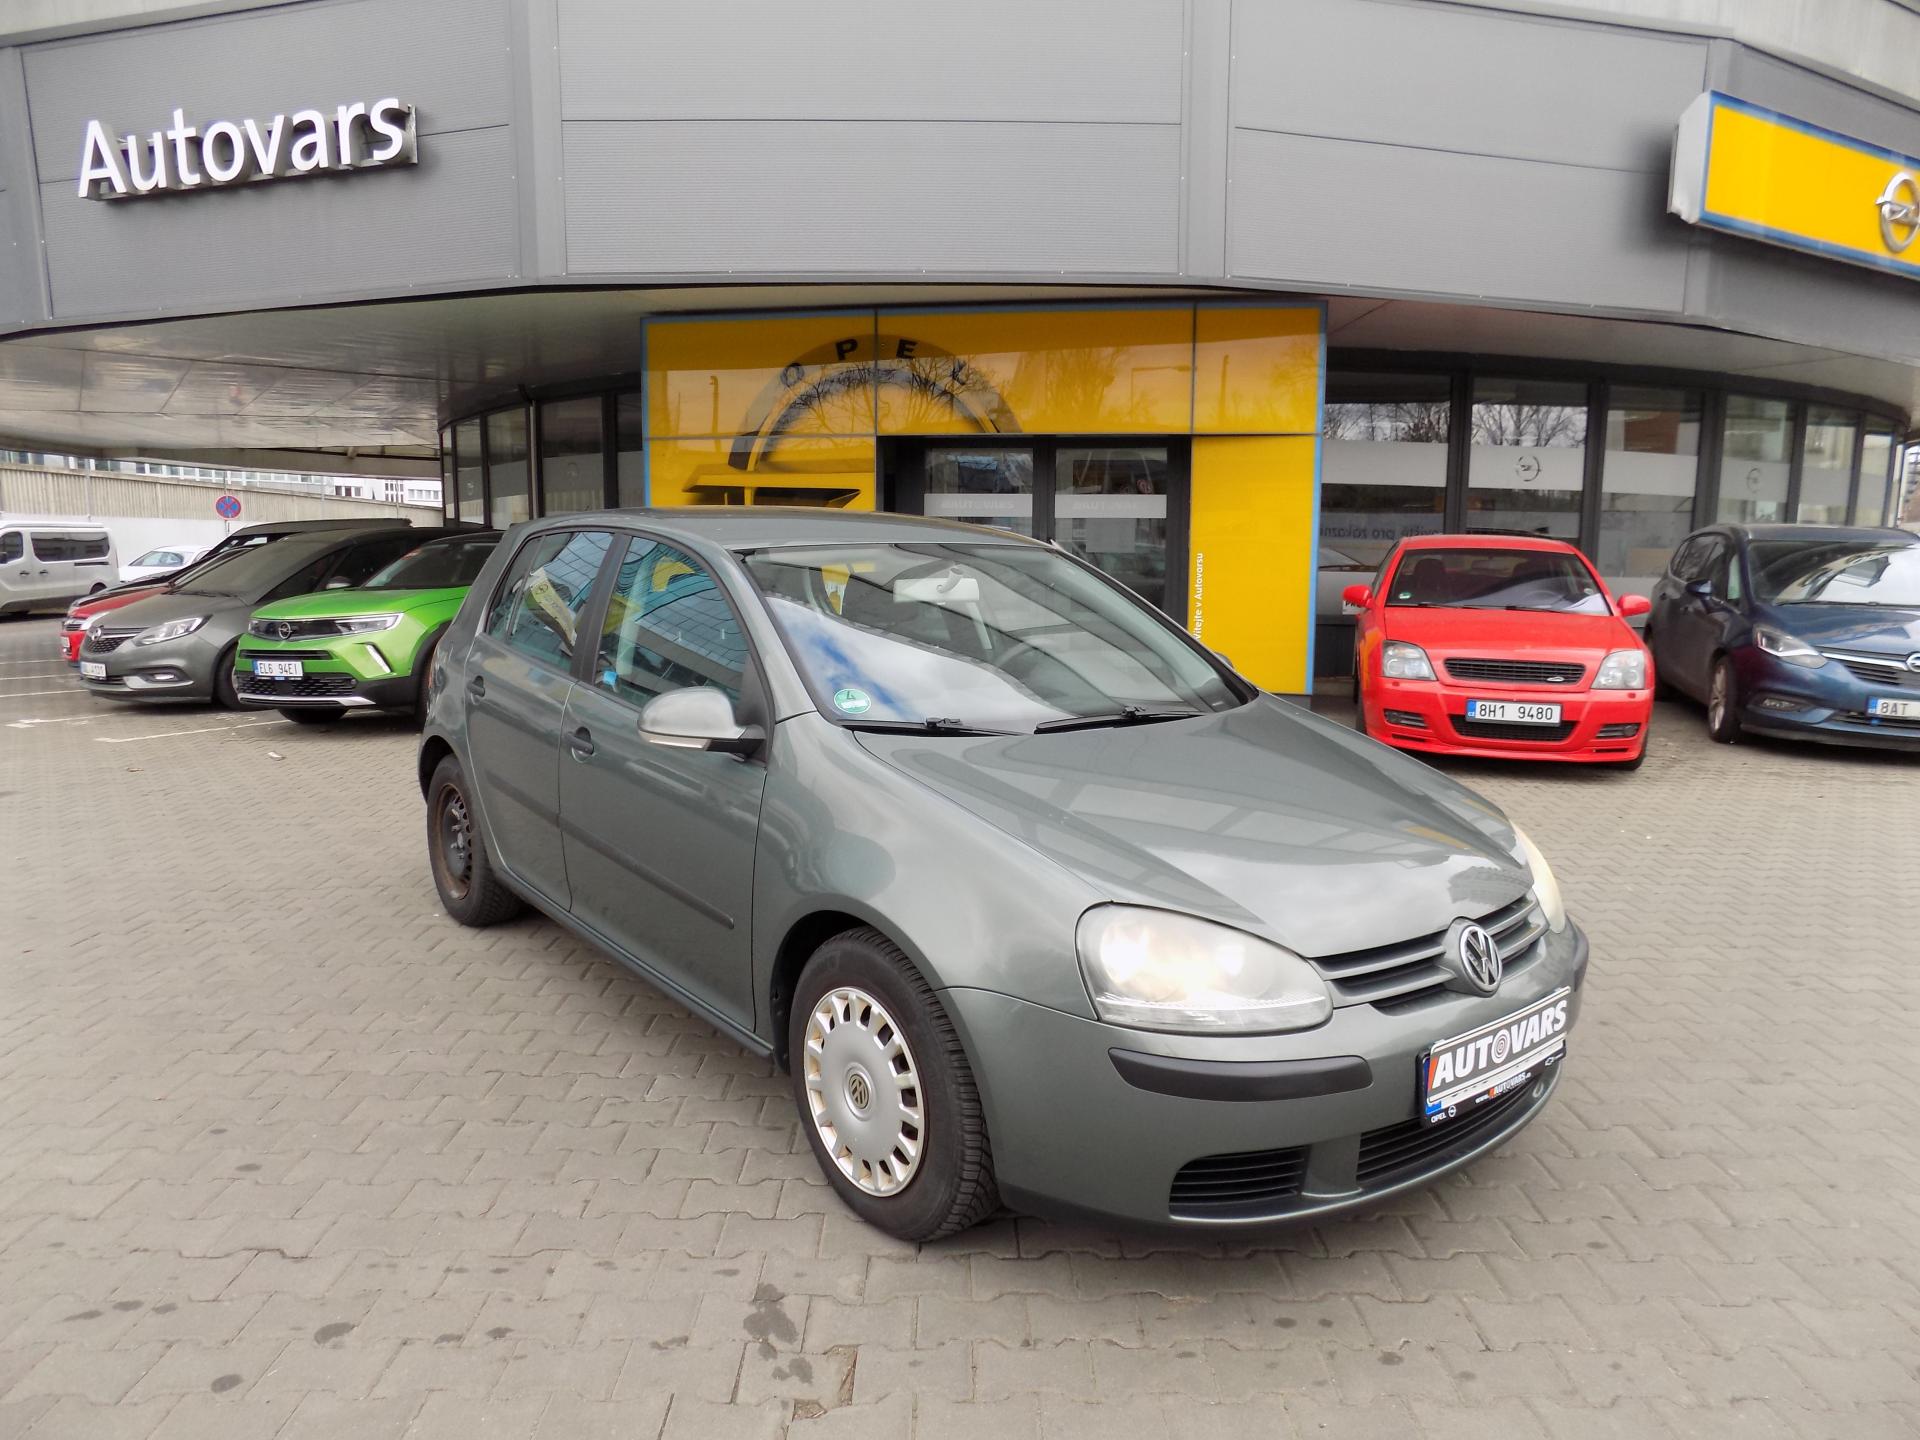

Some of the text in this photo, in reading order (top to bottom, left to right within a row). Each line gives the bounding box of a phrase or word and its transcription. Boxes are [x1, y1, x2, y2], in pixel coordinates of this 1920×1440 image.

[78, 97, 406, 199] Autovars
[1194, 553, 1204, 600] Autovarsu
[1479, 704, 1554, 721] 8H1 9480
[1880, 702, 1909, 716] 8AT
[1432, 1000, 1568, 1089] AUTOVARS
